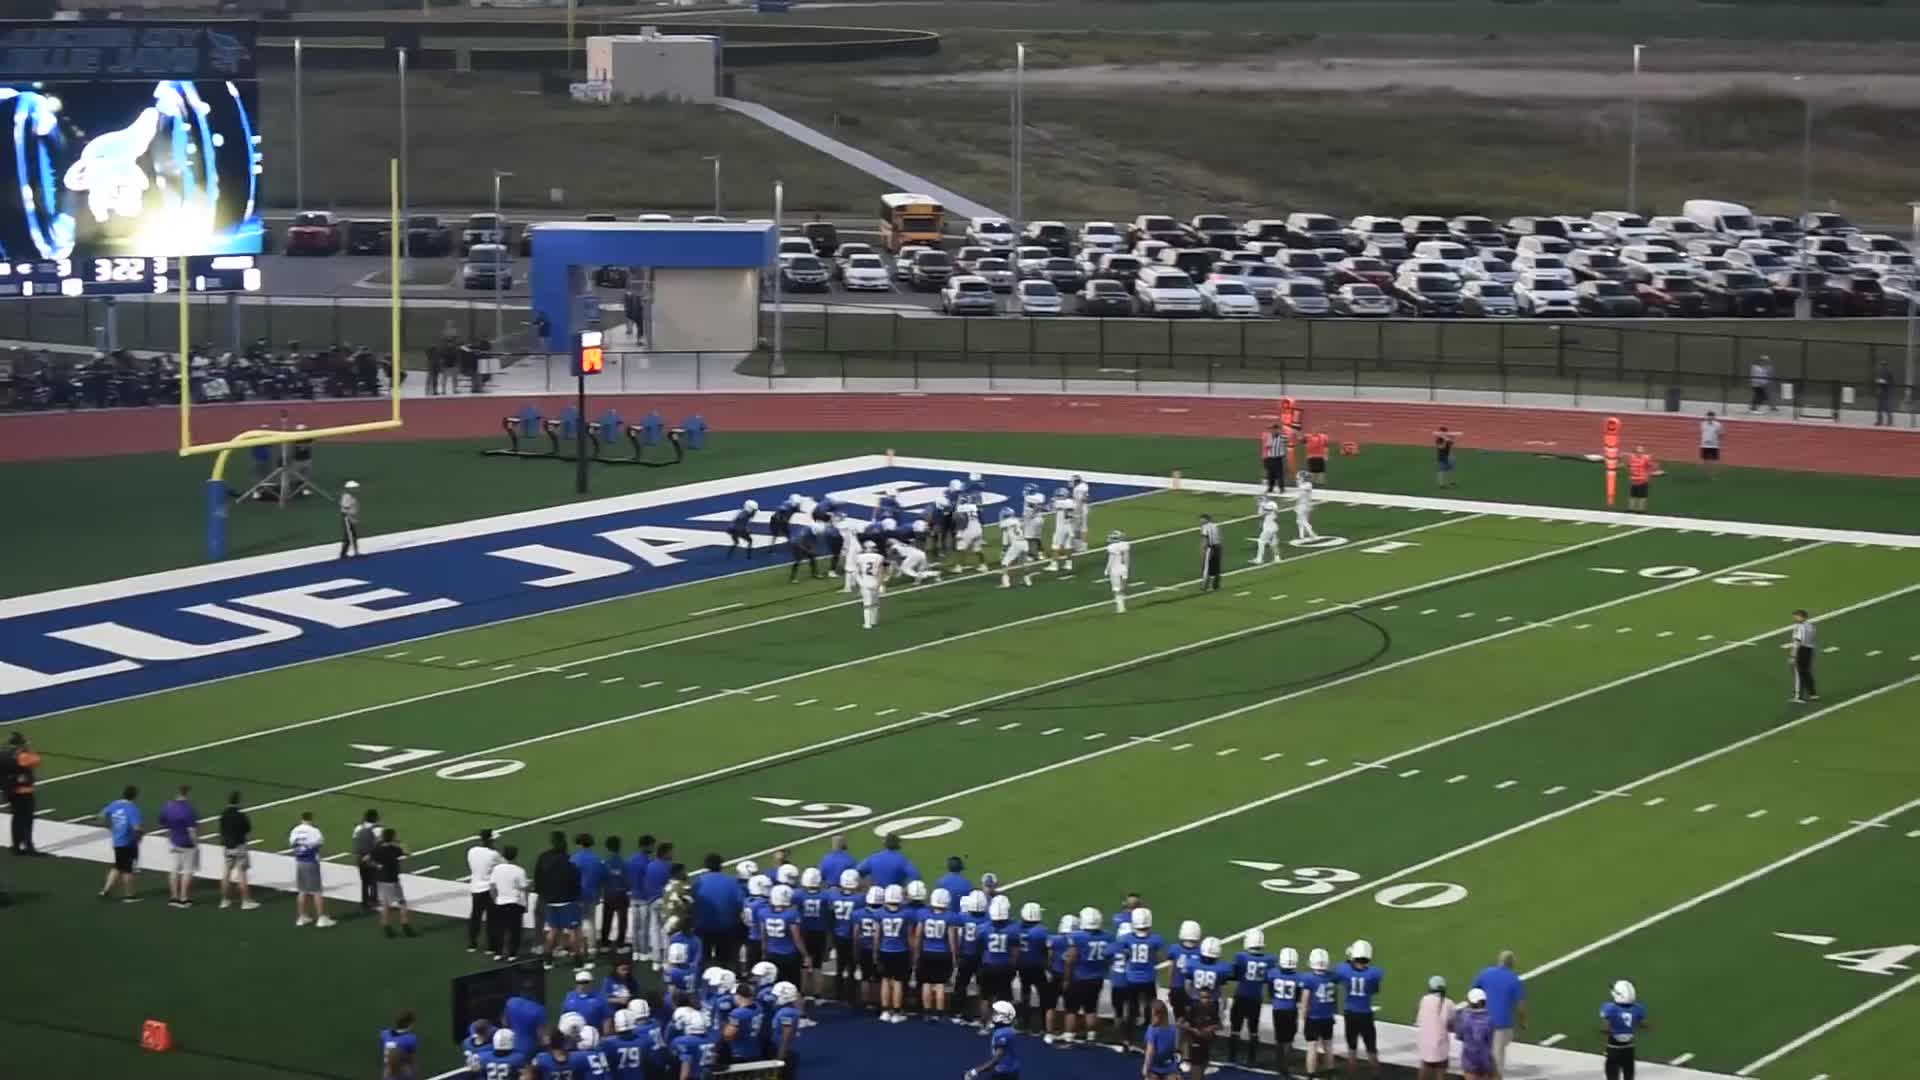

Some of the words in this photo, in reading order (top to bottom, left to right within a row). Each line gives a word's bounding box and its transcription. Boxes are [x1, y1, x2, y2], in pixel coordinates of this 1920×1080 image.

[866, 562, 875, 575] 2
[344, 748, 526, 779] 10
[761, 803, 963, 839] 20
[1261, 867, 1467, 908] 30
[988, 934, 1007, 953] 21
[1131, 943, 1149, 963] 18
[1273, 979, 1296, 999] 93
[1350, 977, 1367, 996] 11
[618, 1047, 640, 1069] 79
